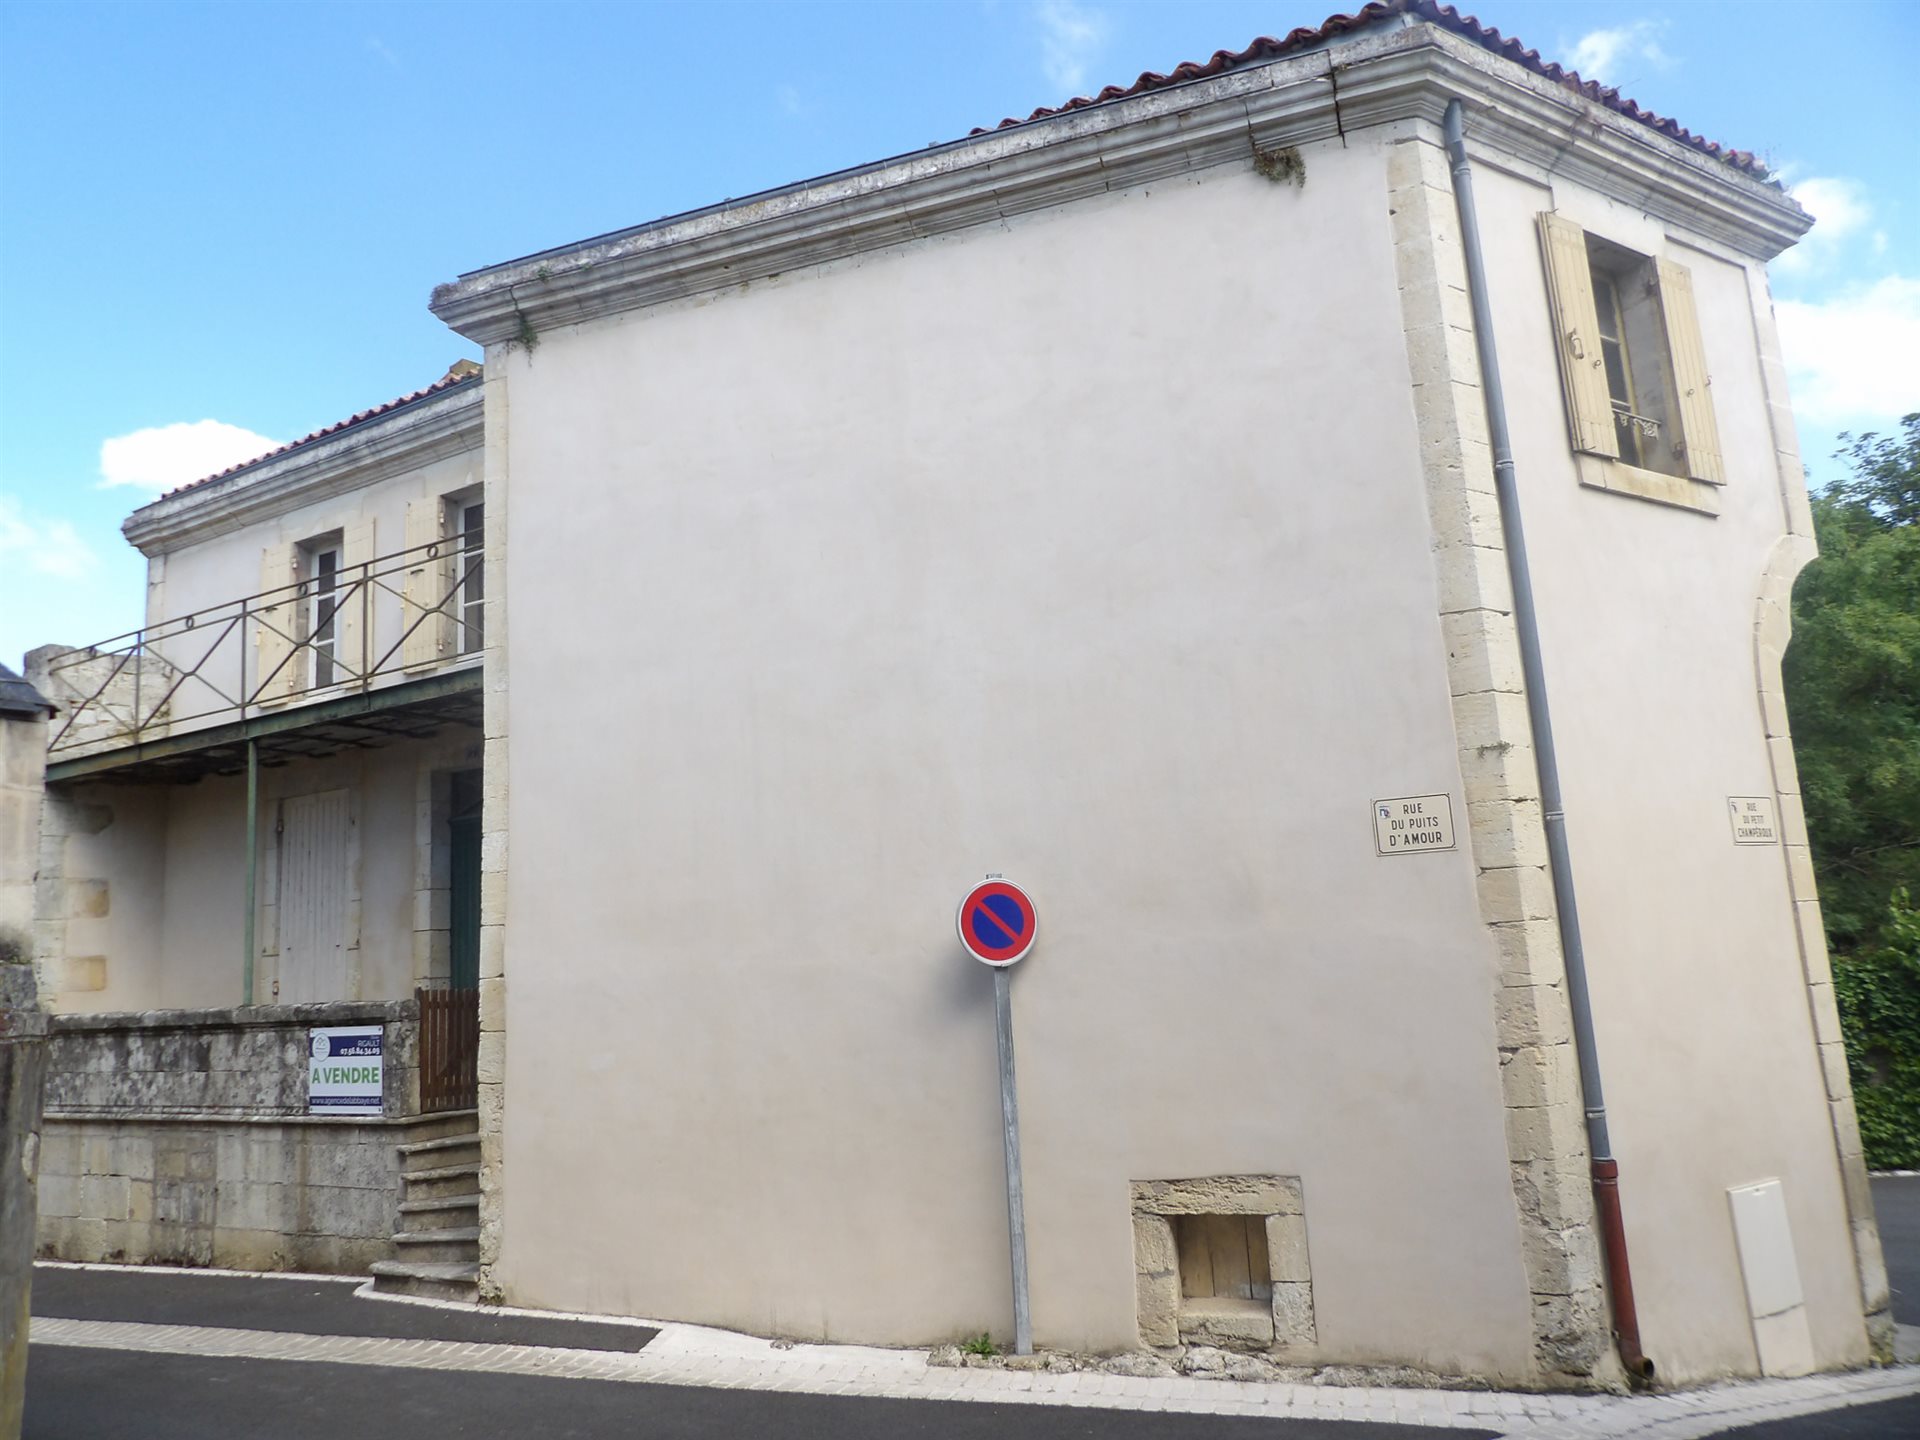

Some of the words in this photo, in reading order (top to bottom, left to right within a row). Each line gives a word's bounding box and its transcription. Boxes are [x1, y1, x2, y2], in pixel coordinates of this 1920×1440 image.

[1403, 803, 1422, 814] RUE
[1746, 803, 1757, 811] RUE
[1391, 820, 1404, 830] DU
[1409, 816, 1438, 828] PUITS
[1743, 816, 1750, 824] DU
[1751, 816, 1764, 824] PETIT
[1390, 832, 1442, 846] D'AMOUR
[312, 1067, 321, 1084] A
[323, 1066, 380, 1084] VENDRE
